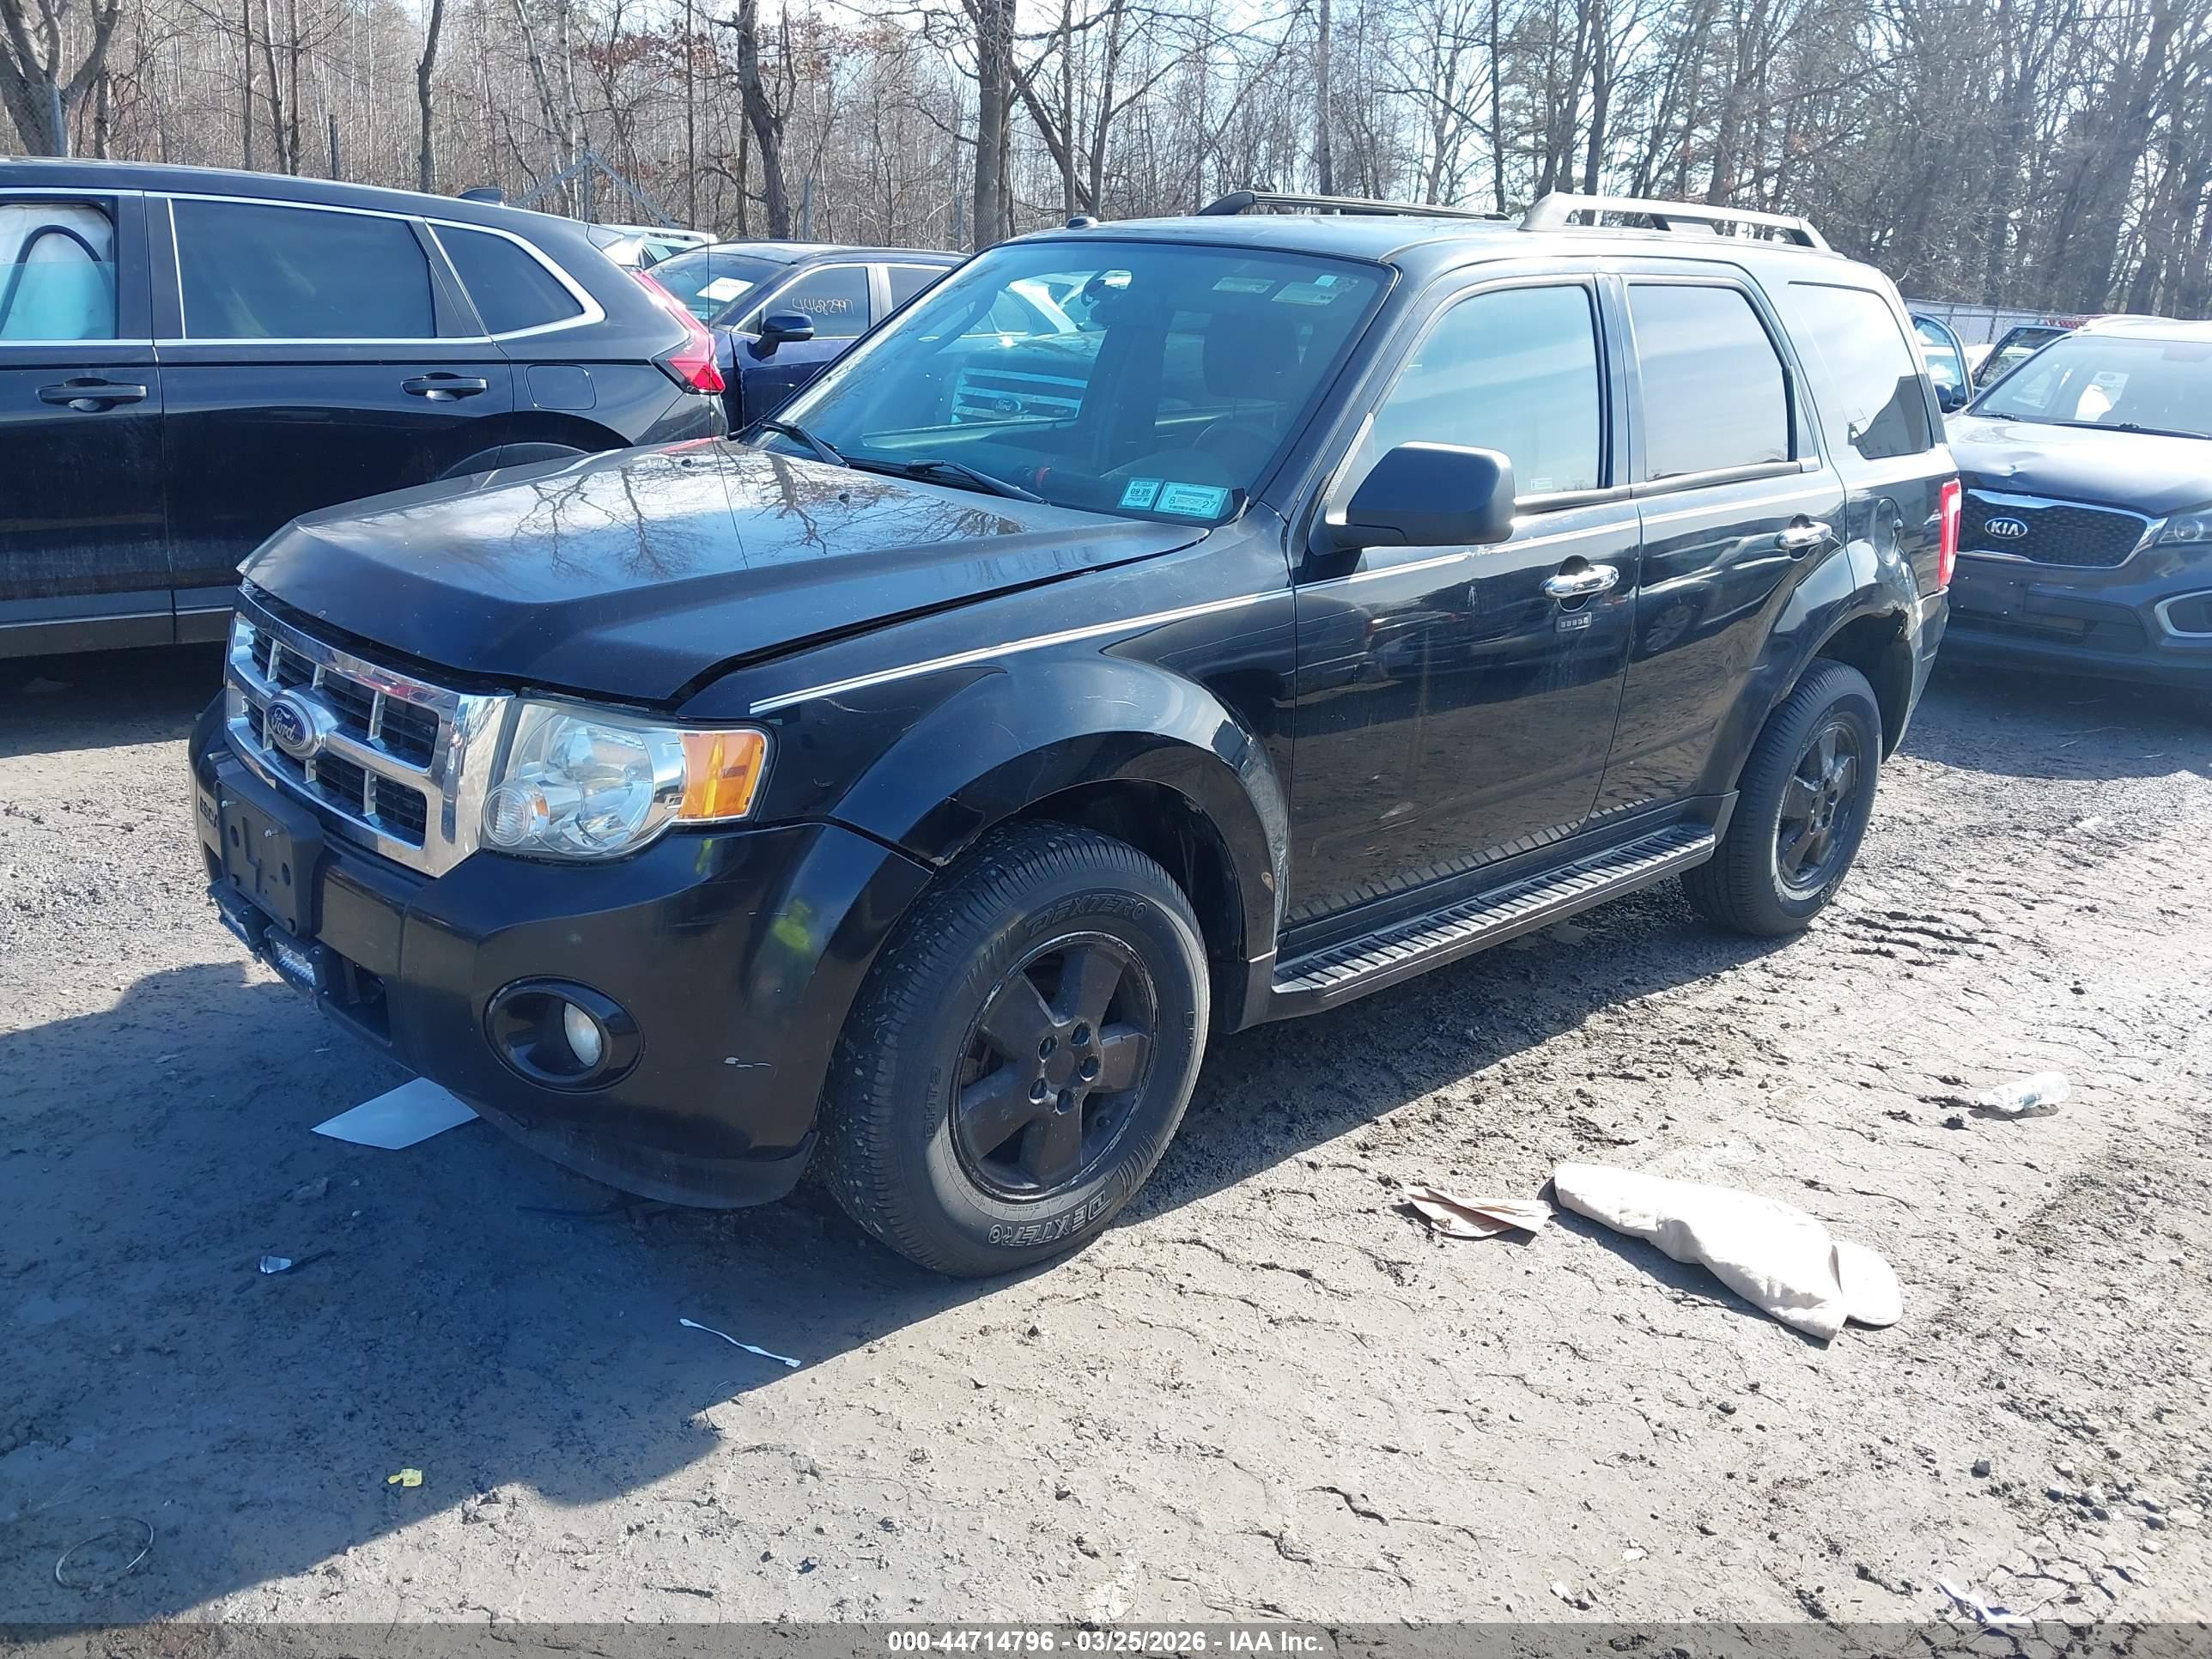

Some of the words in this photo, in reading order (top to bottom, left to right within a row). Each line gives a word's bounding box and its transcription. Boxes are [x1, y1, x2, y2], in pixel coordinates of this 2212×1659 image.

[1201, 501, 1217, 509] 27
[1990, 521, 2019, 535] KIA
[271, 707, 296, 740] Ford
[1024, 894, 1148, 935] DEXTERO
[924, 1066, 942, 1138] DHT2
[988, 1189, 1114, 1247] DEXTERO
